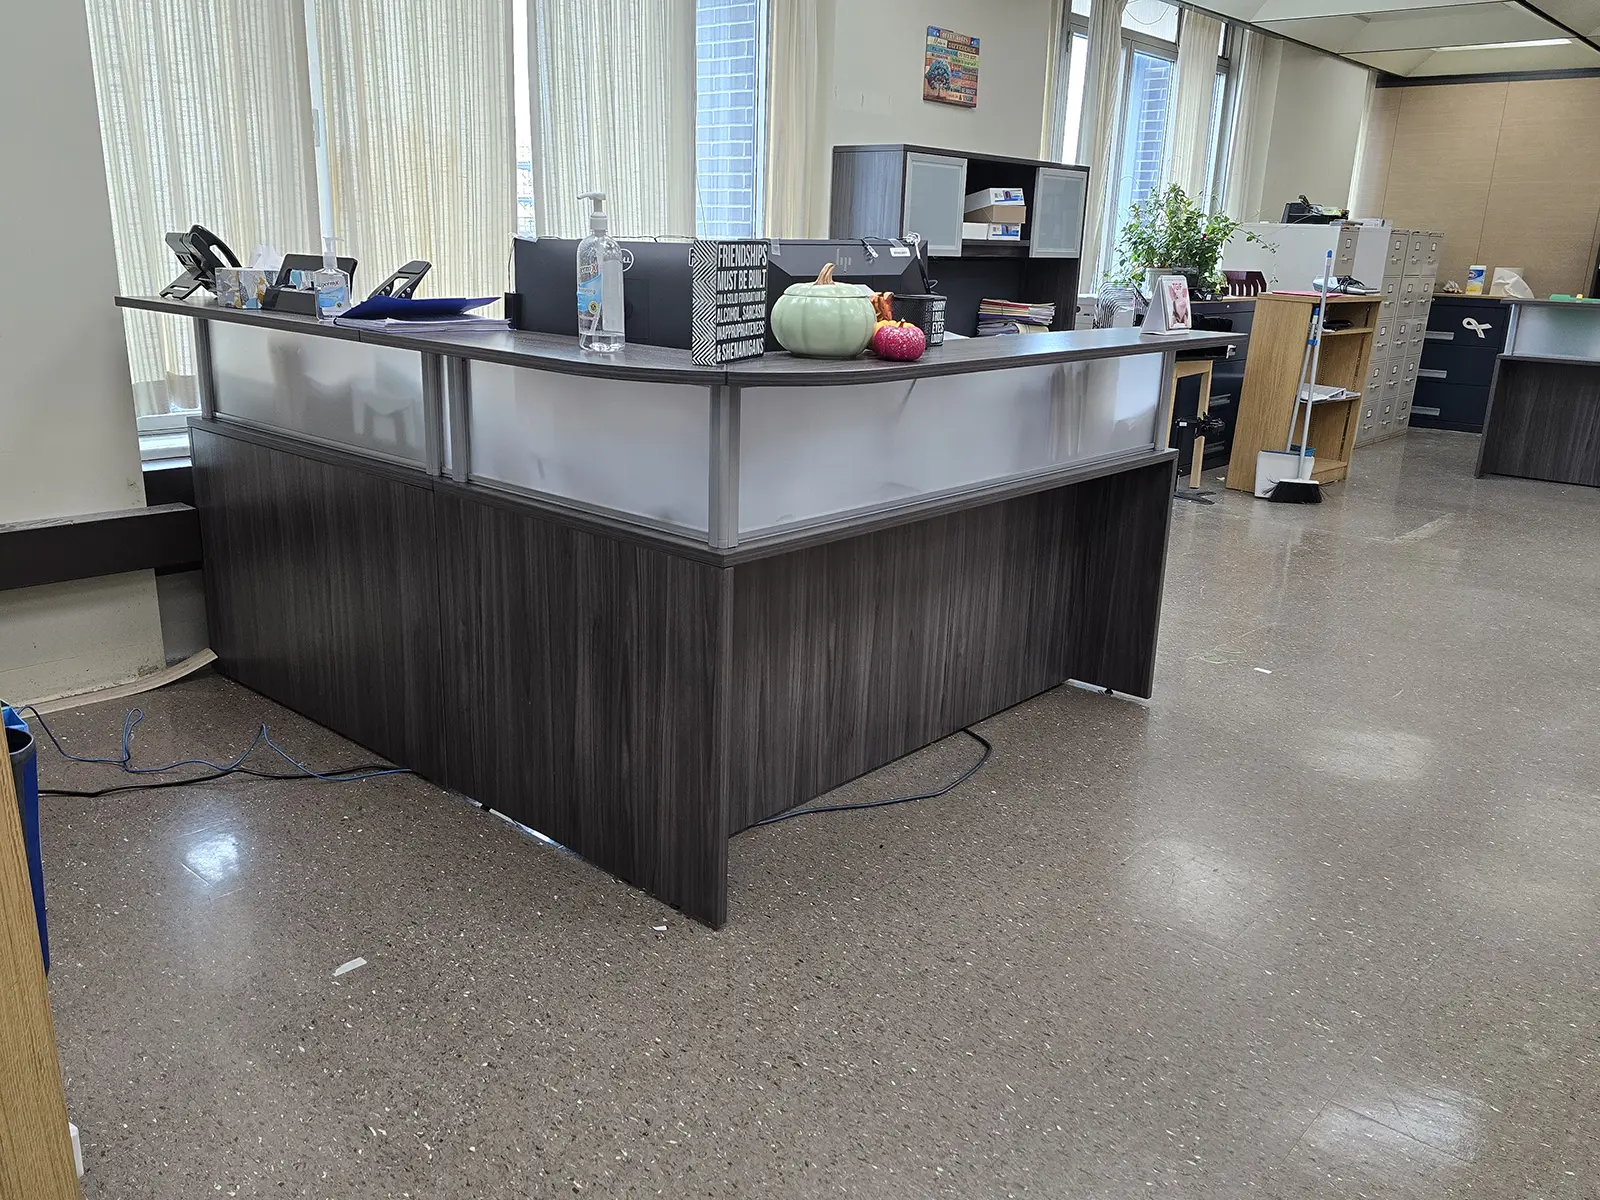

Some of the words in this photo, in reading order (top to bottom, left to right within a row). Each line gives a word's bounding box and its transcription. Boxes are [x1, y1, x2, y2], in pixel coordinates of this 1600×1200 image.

[718, 244, 767, 267] FRIENDSHIPS
[717, 270, 737, 291] MUST
[739, 270, 747, 289] BE
[749, 269, 766, 288] BUILT
[727, 293, 738, 304] SOLID
[739, 291, 760, 303] FOUNDATION
[717, 321, 764, 340] INAPPROPRIATENESS
[932, 322, 944, 333] EYES
[717, 345, 721, 361] &
[722, 338, 763, 360] SHENANIGANS
